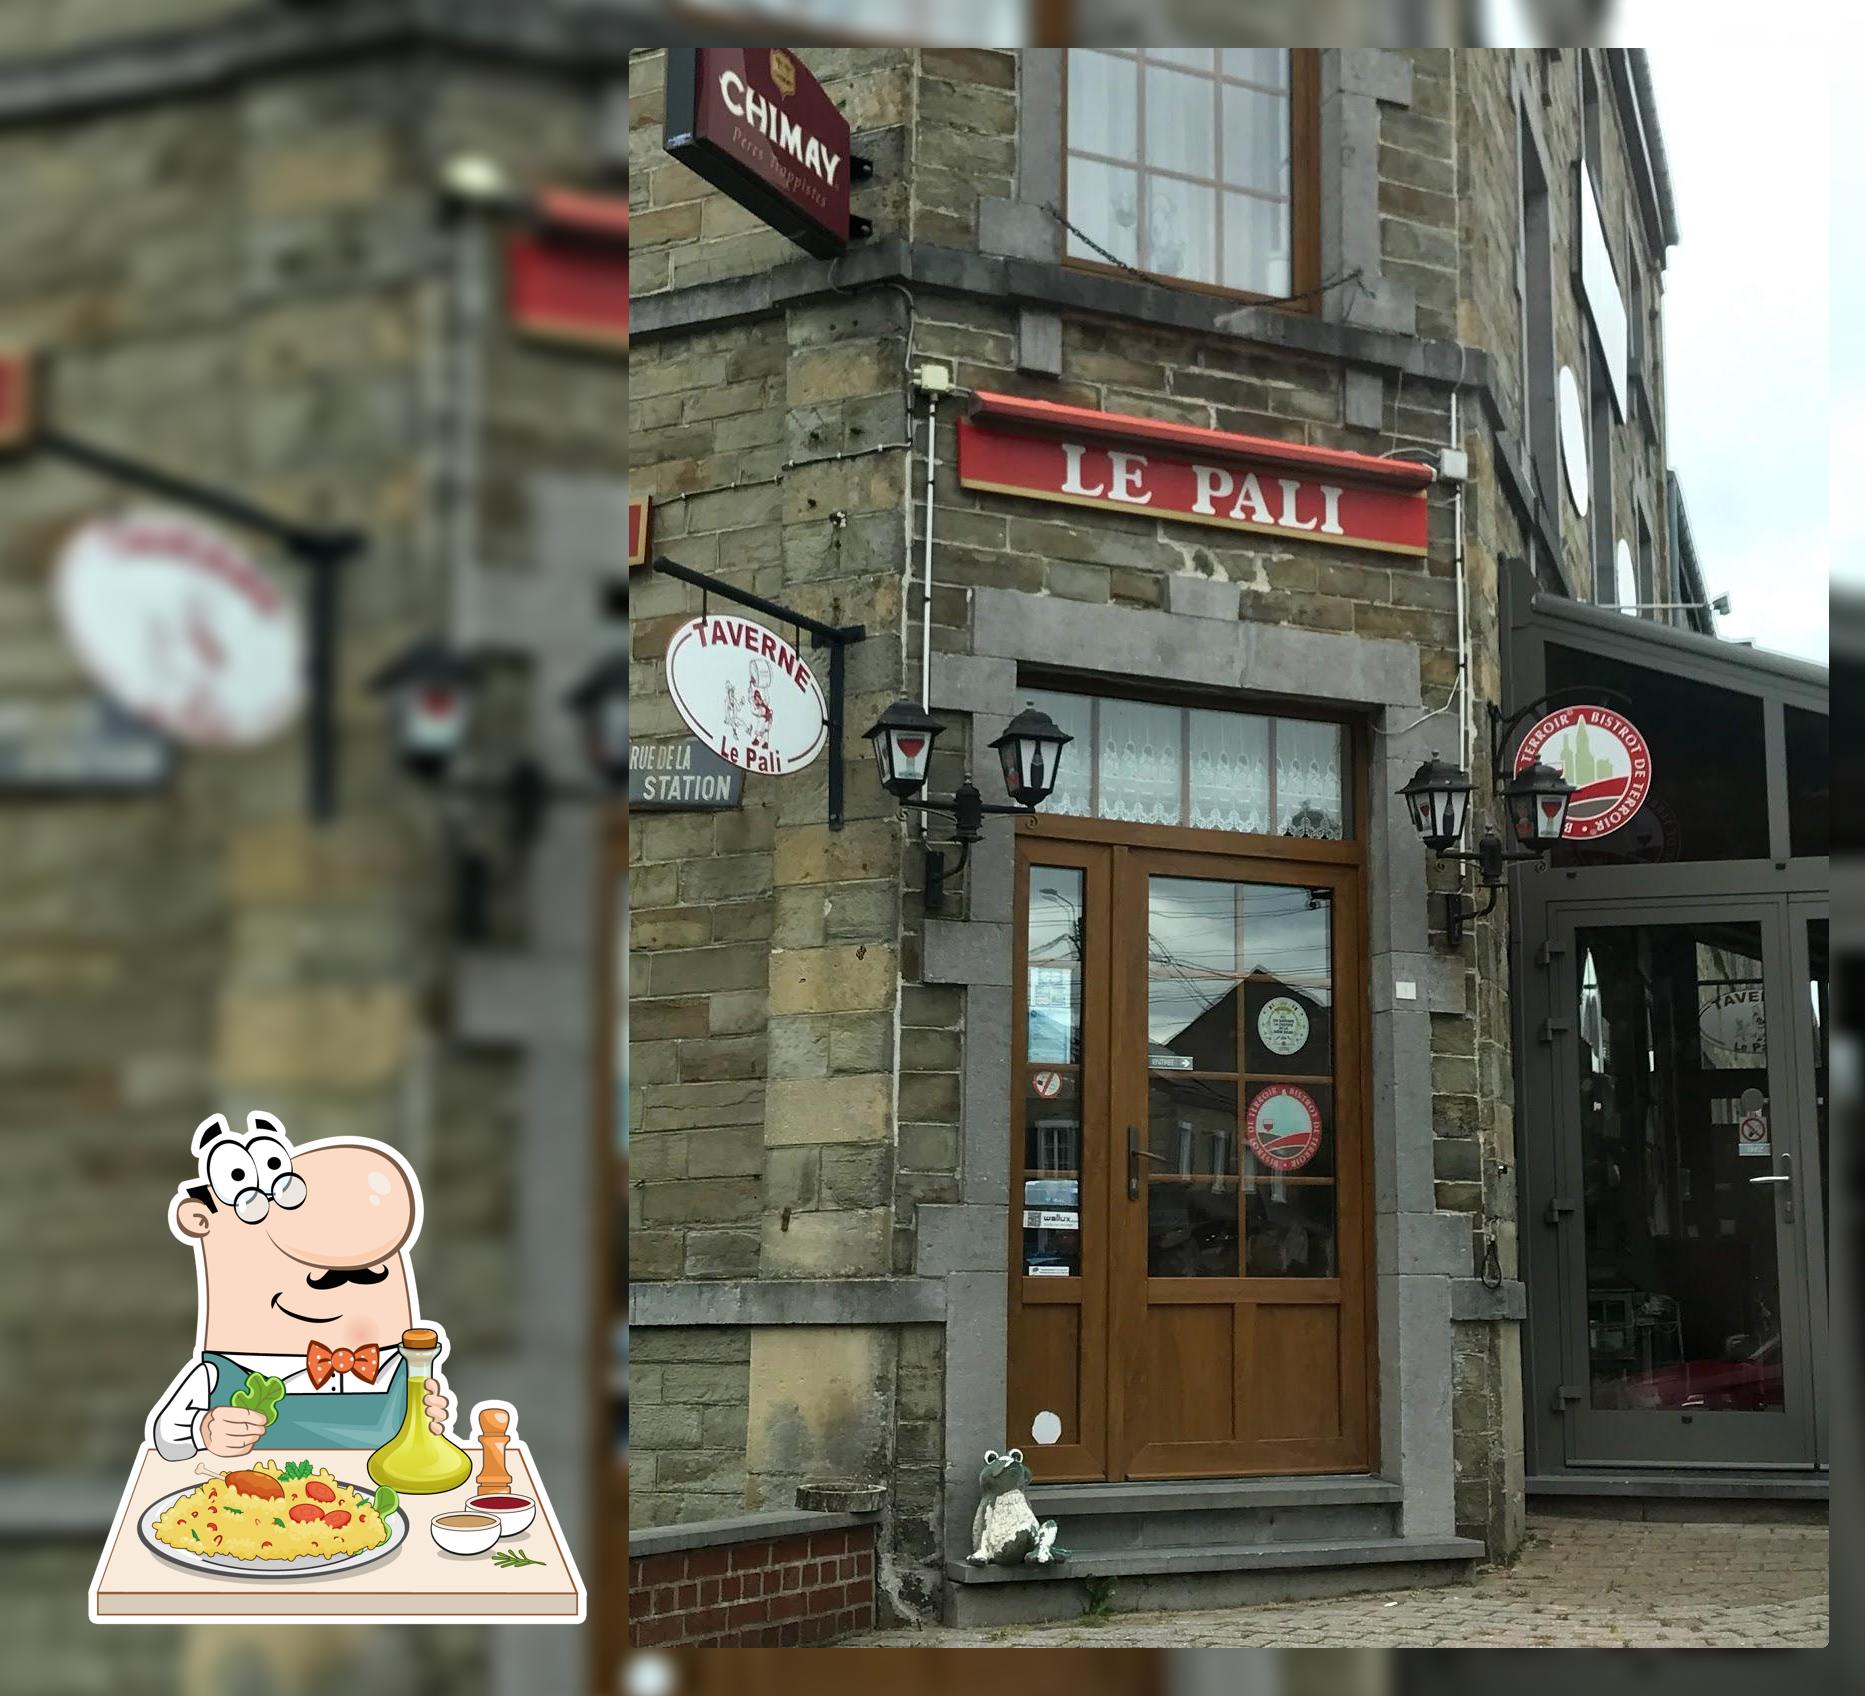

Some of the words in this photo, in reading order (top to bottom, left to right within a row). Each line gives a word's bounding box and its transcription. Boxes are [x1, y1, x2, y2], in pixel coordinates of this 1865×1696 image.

[719, 70, 841, 186] CHIMAY
[1061, 443, 1152, 505] LE
[1192, 464, 1344, 535] PALI
[692, 620, 811, 694] TAVERNE
[630, 745, 655, 770] RUE
[720, 736, 739, 762] Le
[746, 747, 781, 772] Pali
[1591, 711, 1641, 757] BISTROT
[1634, 759, 1646, 779] DE
[643, 775, 731, 801] STATION
